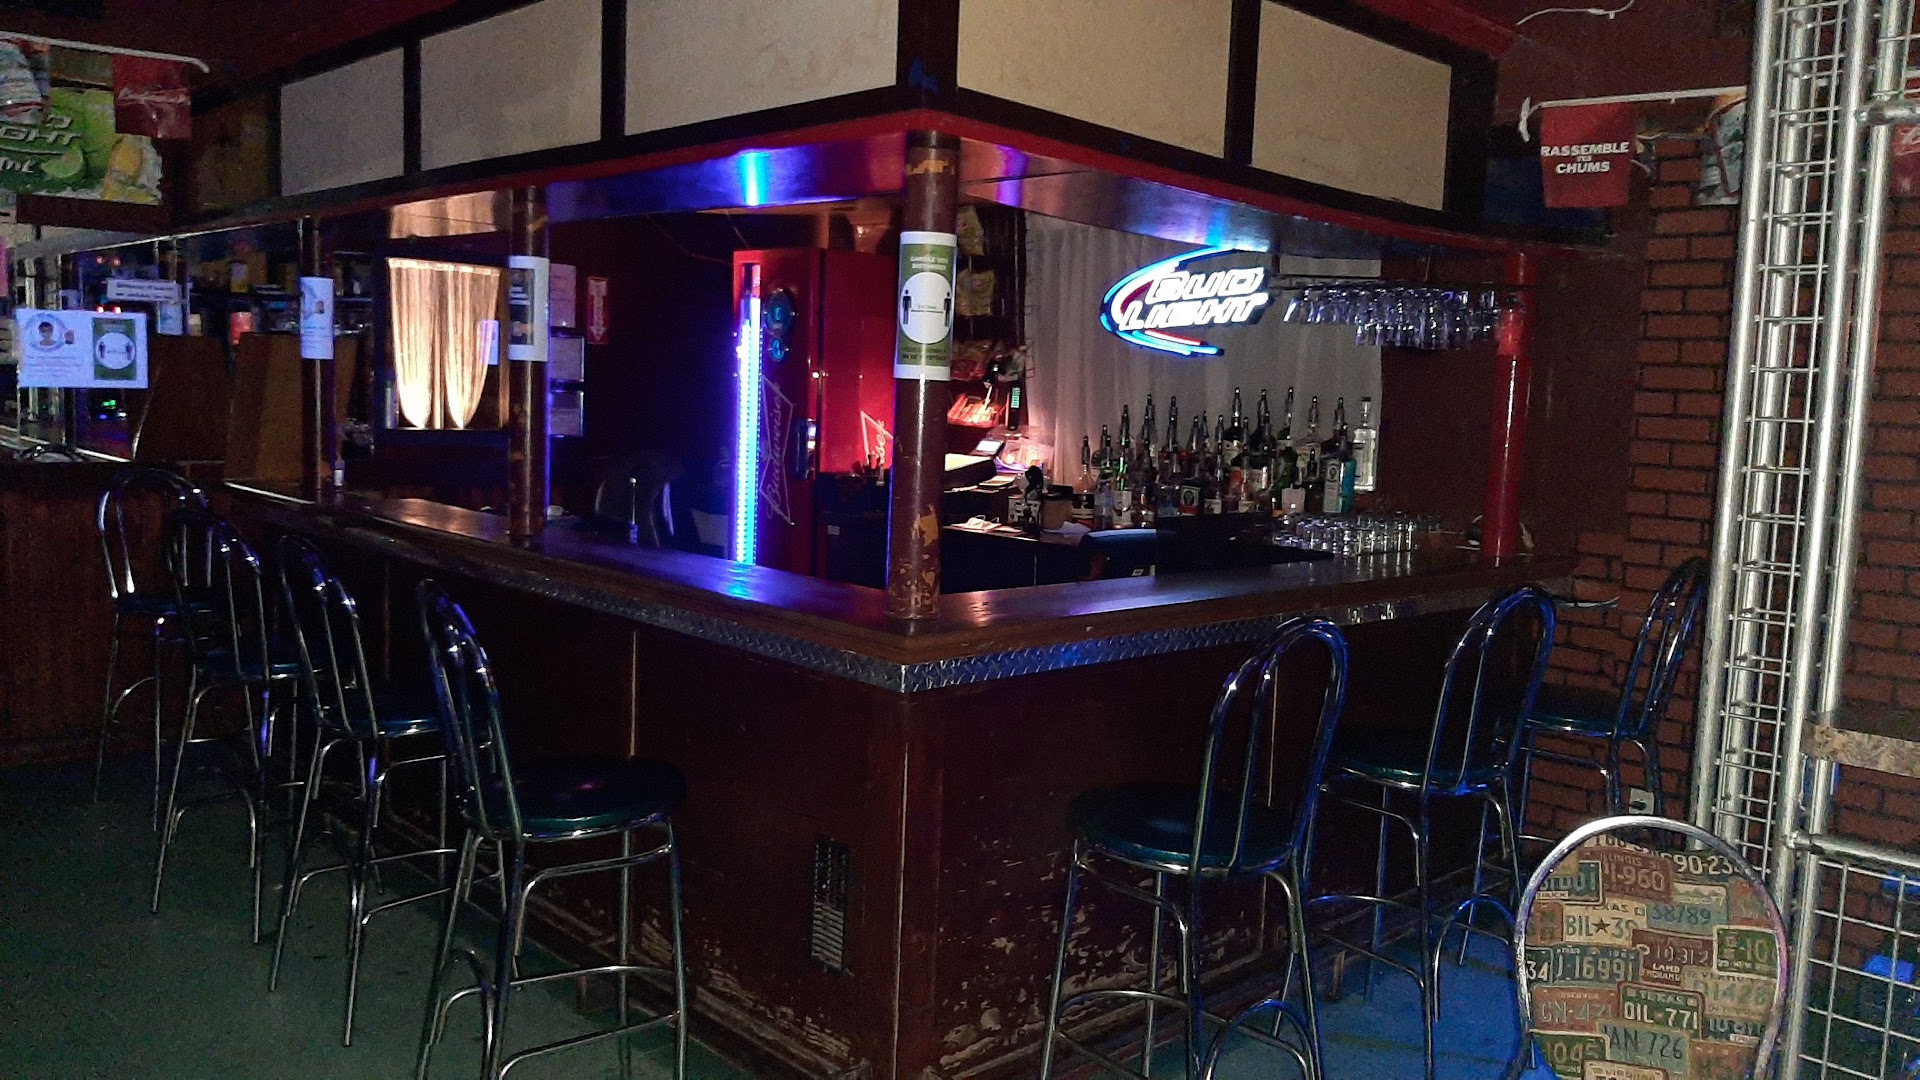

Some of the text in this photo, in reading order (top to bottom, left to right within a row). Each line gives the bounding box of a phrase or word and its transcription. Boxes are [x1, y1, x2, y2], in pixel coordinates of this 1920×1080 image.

[1540, 142, 1630, 157] RASSEMBLE
[1556, 161, 1611, 174] CHUMS
[1145, 266, 1265, 305] BUD
[1118, 292, 1270, 332] LIGHT
[1566, 914, 1593, 937] BIL
[1664, 1008, 1699, 1030] 771
[1647, 1032, 1683, 1060] 726
